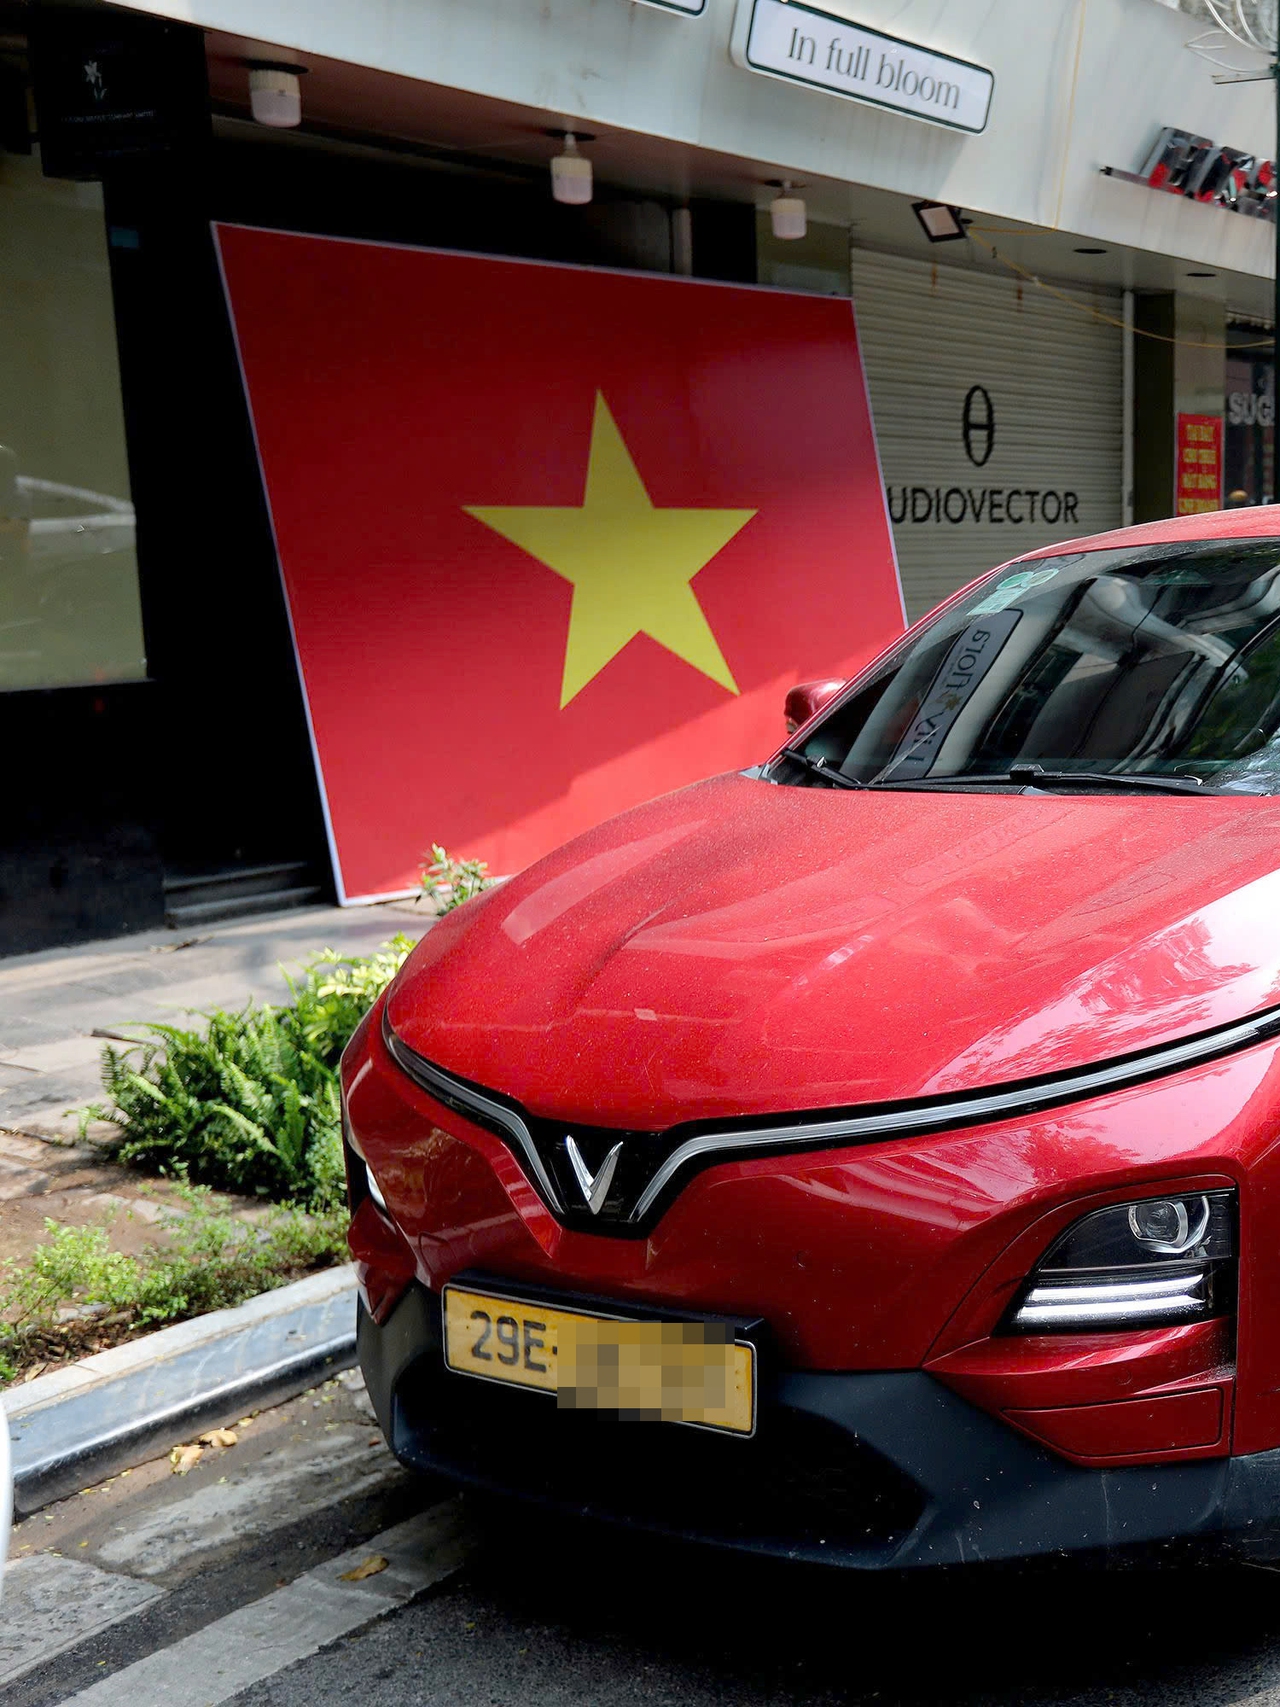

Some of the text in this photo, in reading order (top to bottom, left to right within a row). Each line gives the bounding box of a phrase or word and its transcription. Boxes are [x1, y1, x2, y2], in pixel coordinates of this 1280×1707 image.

[787, 27, 962, 110] In full bloom
